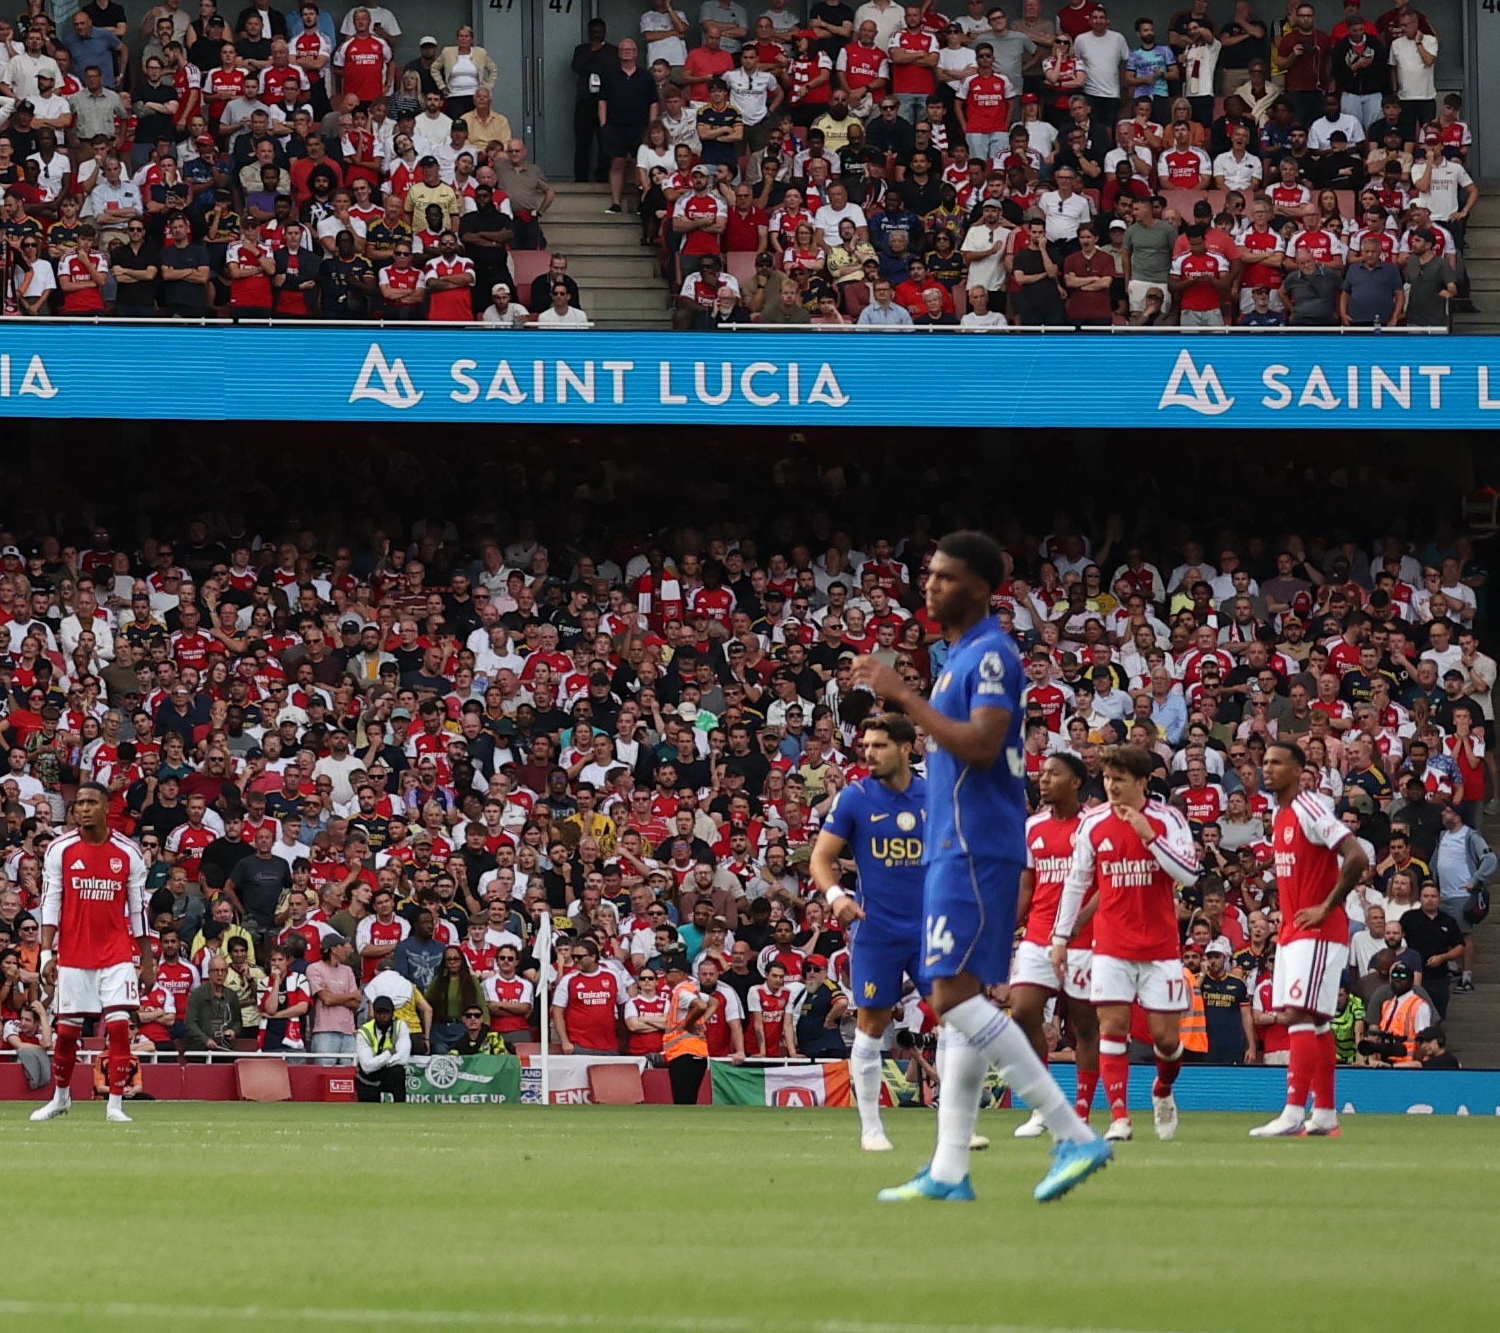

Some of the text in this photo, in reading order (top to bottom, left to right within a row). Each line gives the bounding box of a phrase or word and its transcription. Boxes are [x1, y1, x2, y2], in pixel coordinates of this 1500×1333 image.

[450, 357, 851, 409] SAINT LUCIA
[1261, 363, 1451, 411] SAINT
[1102, 858, 1160, 876] Emirates
[71, 876, 122, 891] Emirates
[926, 914, 955, 954] 14
[124, 980, 138, 1000] 15
[1167, 978, 1183, 1002] 17
[1289, 978, 1303, 1000] 6
[434, 1093, 457, 1104] I'LL
[460, 1093, 488, 1104] GET
[490, 1093, 507, 1103] UP
